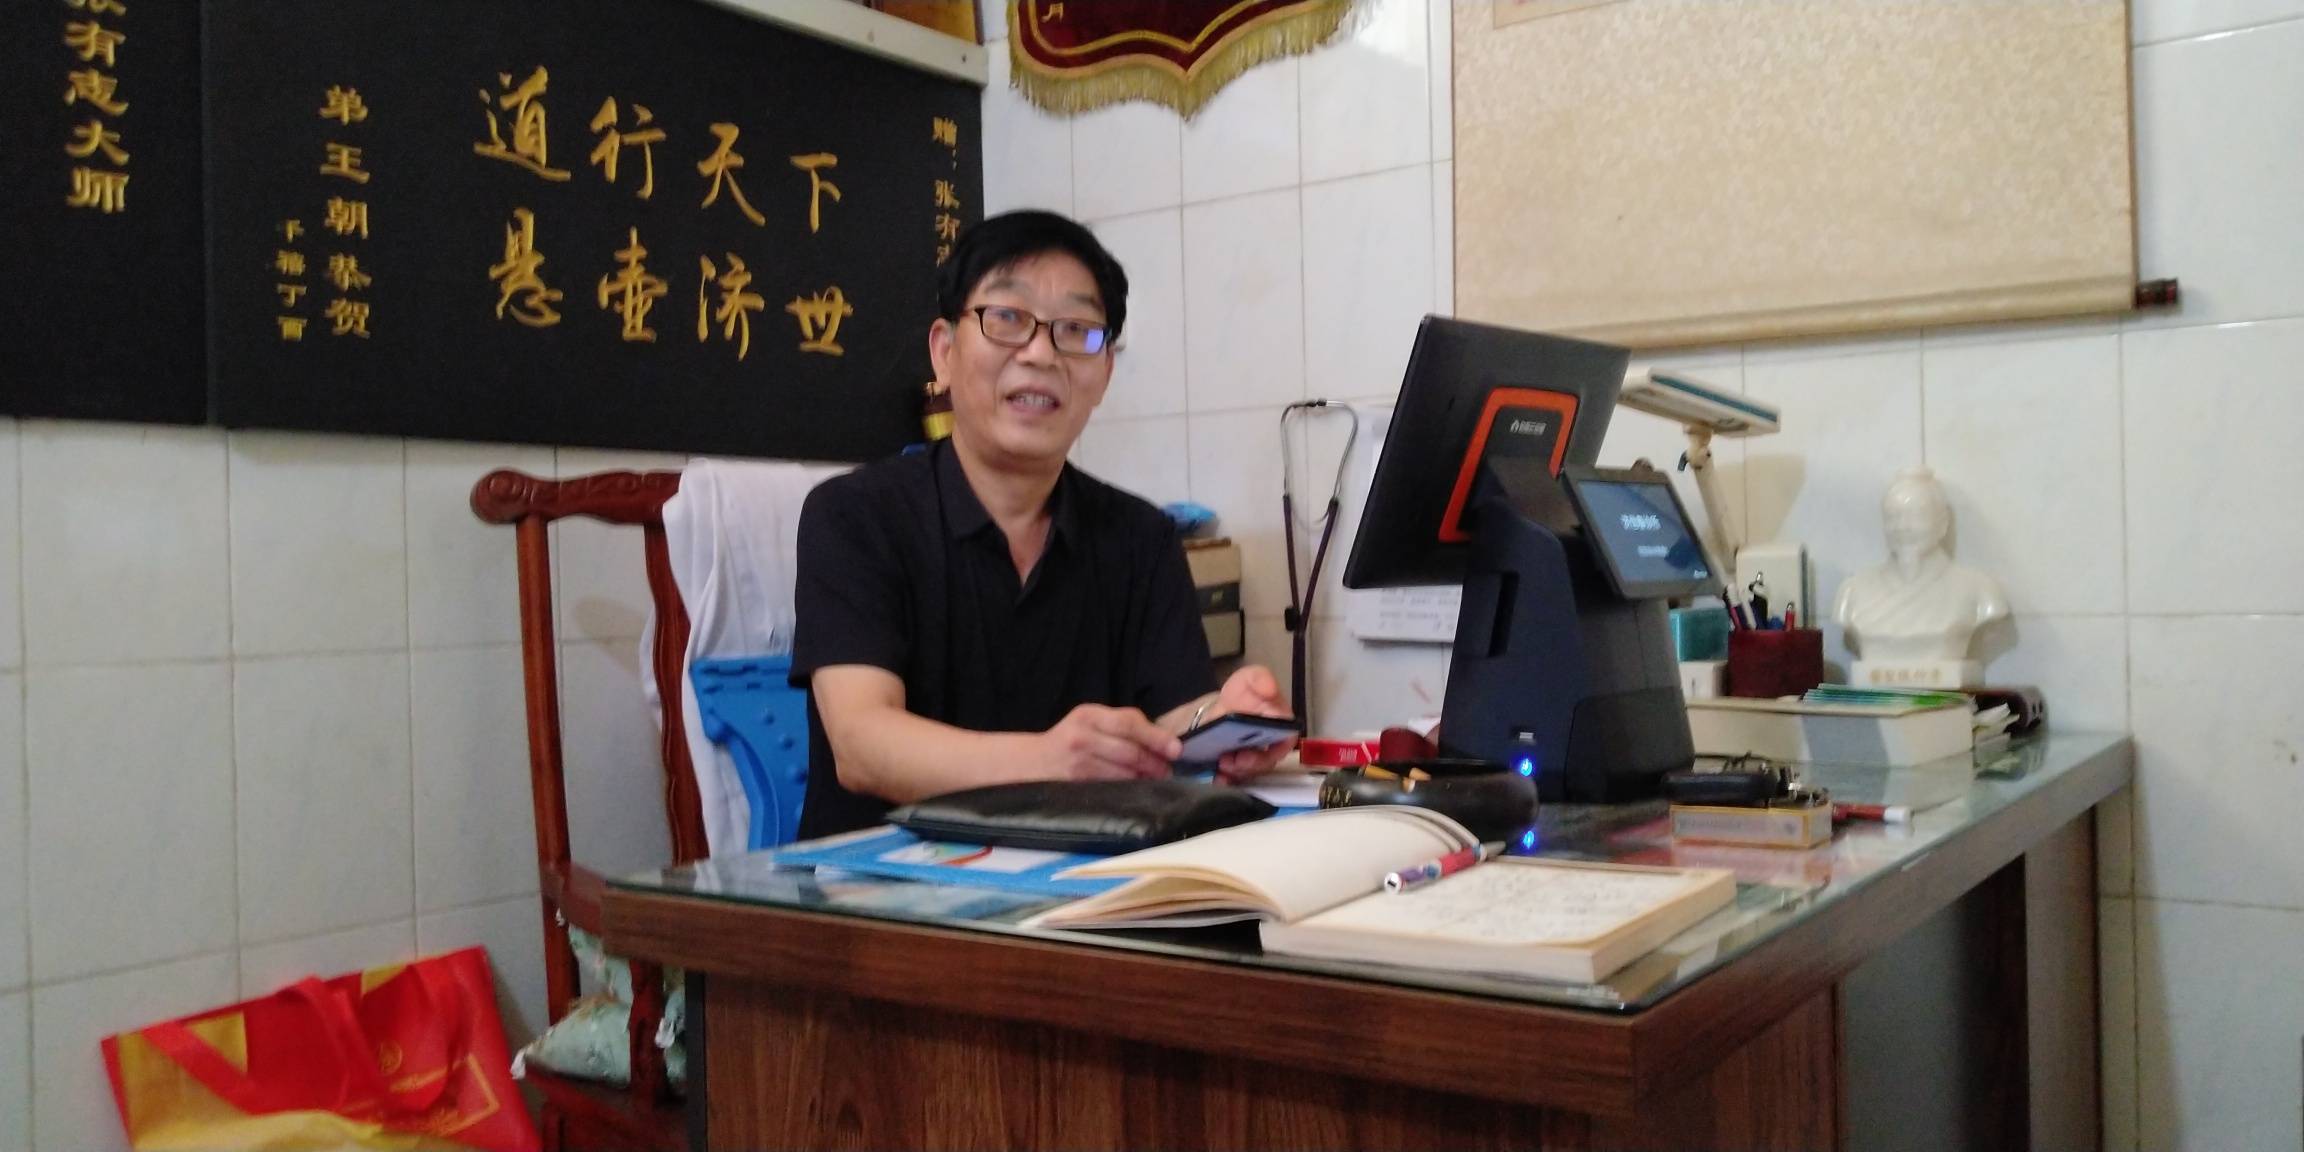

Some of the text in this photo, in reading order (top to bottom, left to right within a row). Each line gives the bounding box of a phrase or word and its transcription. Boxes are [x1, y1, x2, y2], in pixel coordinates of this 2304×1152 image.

[474, 65, 842, 234] 道行天下
[488, 207, 854, 361] 悬壶济世
